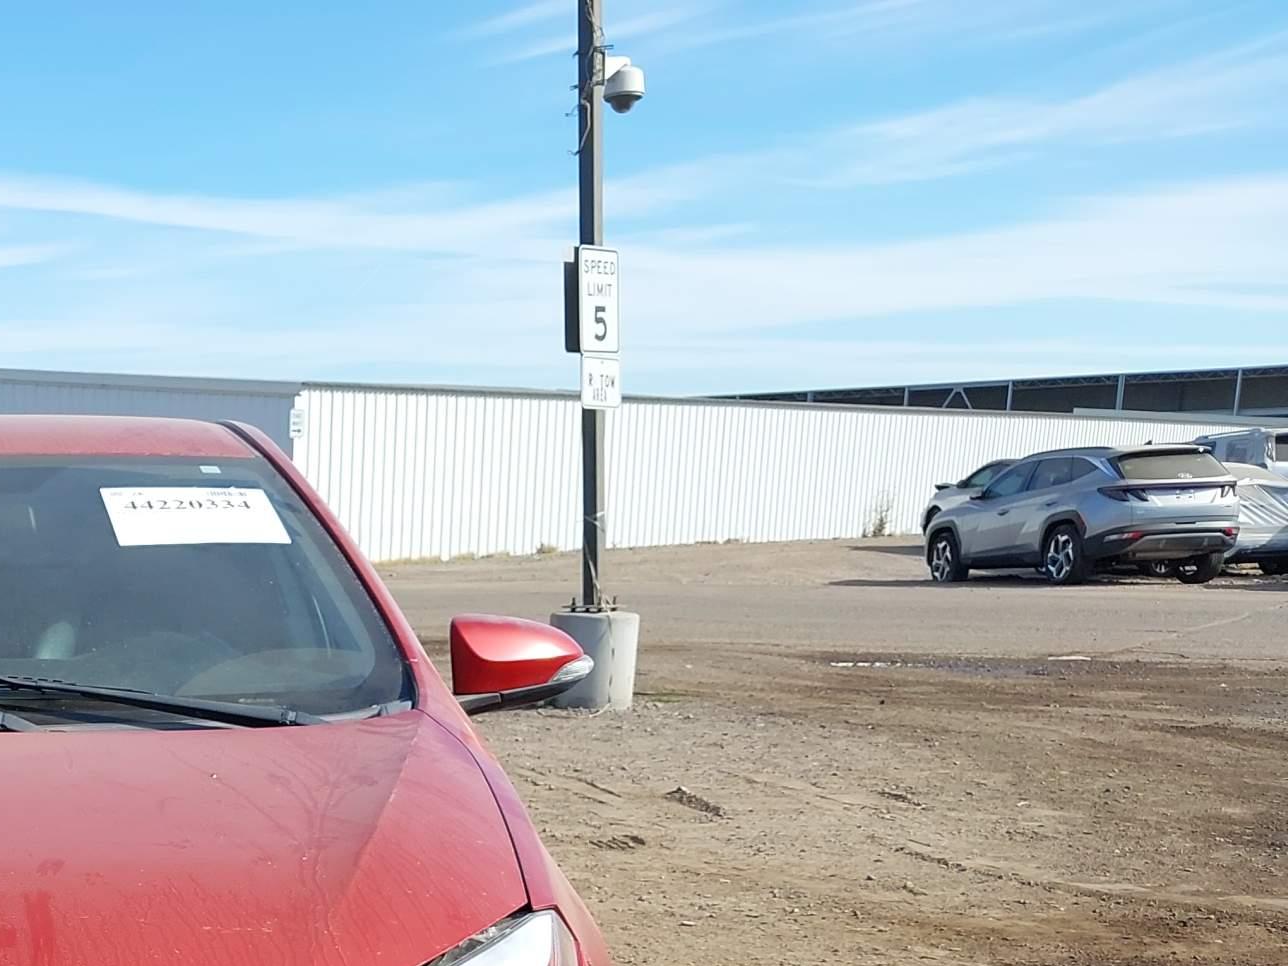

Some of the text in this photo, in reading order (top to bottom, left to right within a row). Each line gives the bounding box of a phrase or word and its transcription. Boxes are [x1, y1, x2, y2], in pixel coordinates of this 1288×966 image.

[584, 259, 616, 275] SPEED
[587, 282, 612, 296] LIMIT
[594, 306, 607, 342] 5
[123, 499, 252, 510] 44220334
